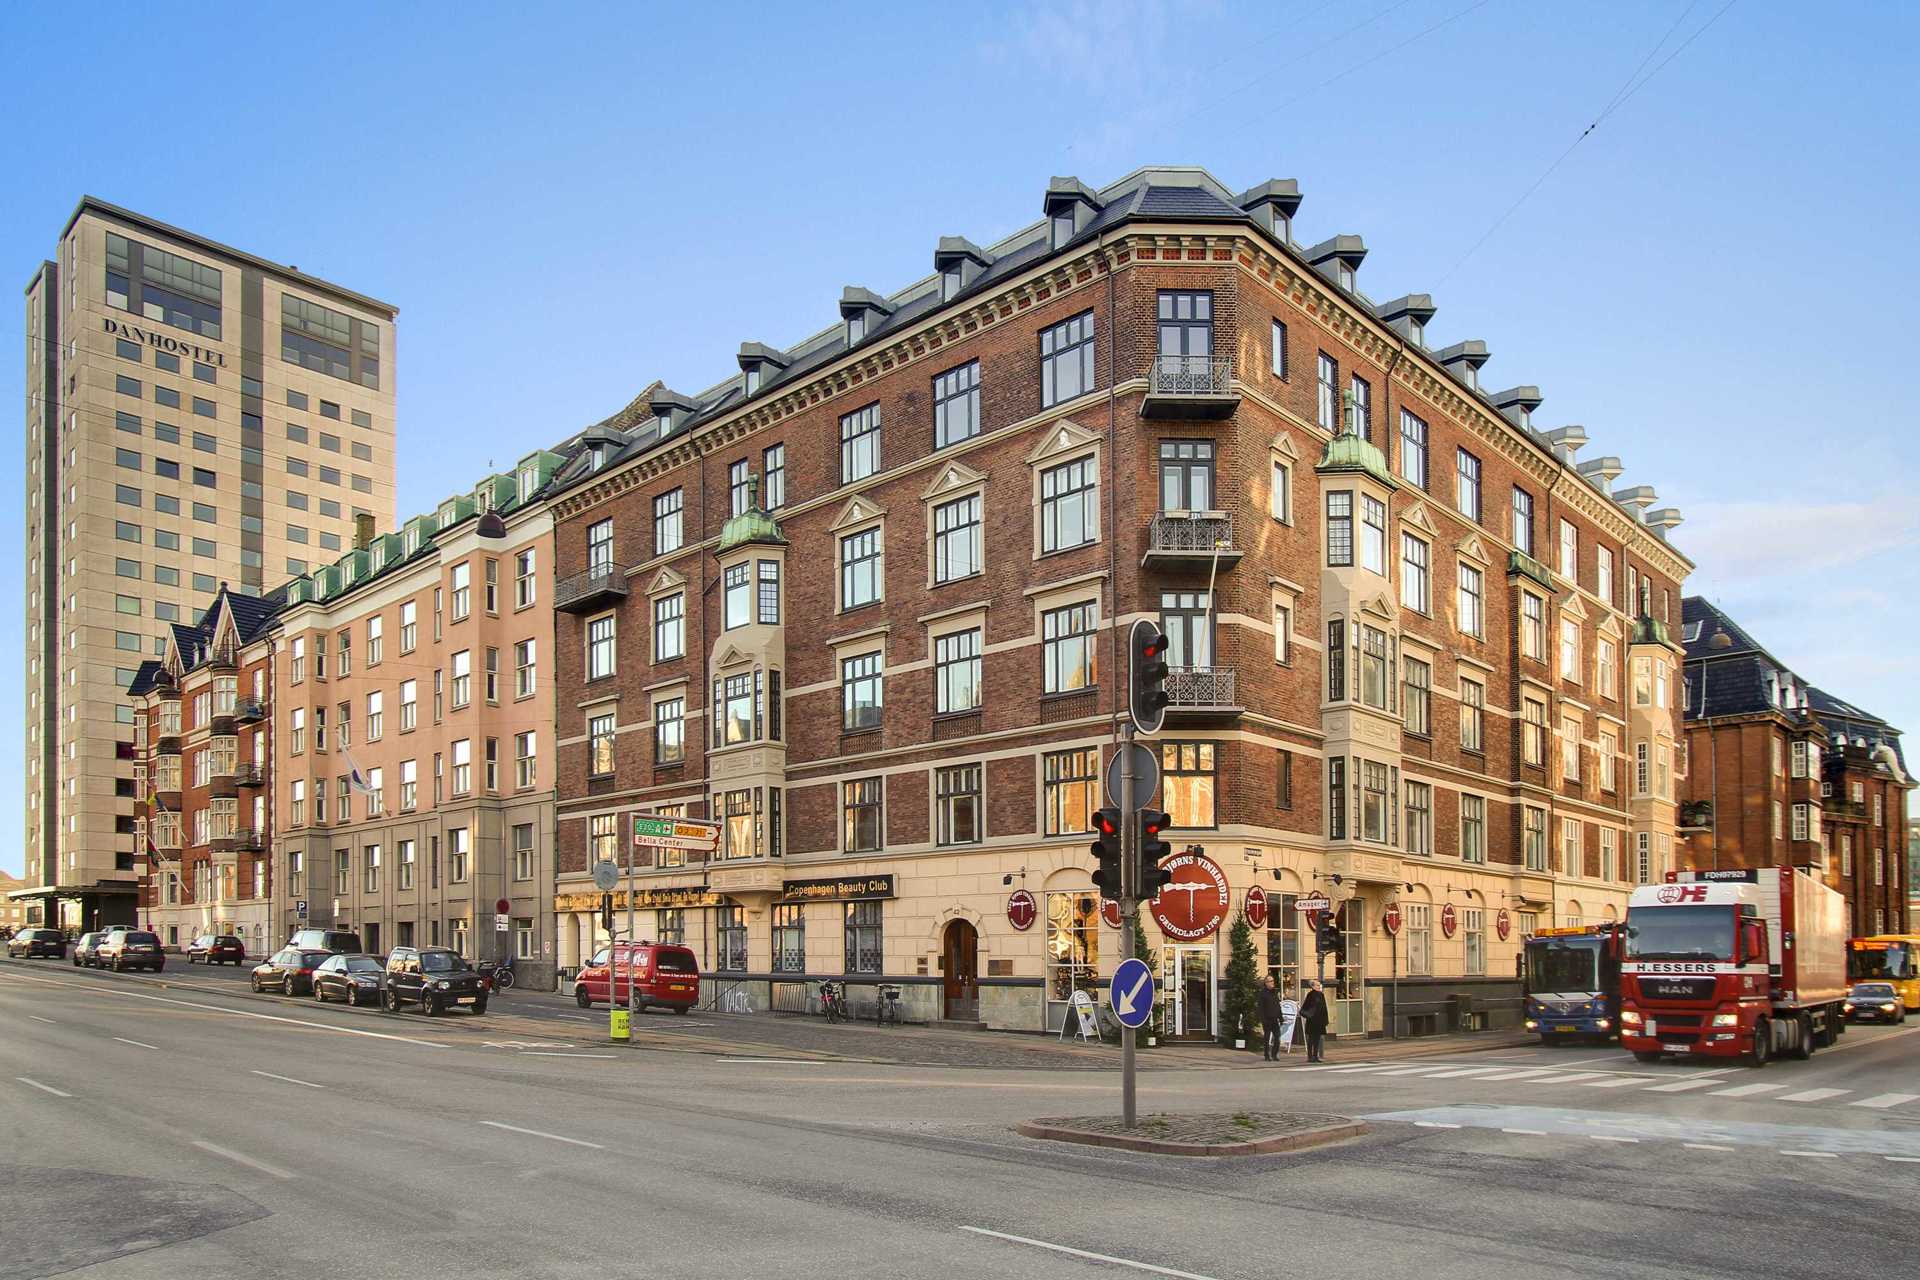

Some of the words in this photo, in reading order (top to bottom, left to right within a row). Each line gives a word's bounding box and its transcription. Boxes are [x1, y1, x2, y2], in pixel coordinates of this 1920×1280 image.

[103, 318, 228, 368] DANHOSTEL
[638, 836, 656, 844] Bella
[659, 838, 683, 846] Center
[789, 884, 836, 897] Copenhagen
[838, 882, 866, 894] Beauty
[869, 880, 888, 891] Club
[1197, 856, 1228, 905] VINHANDEL
[1677, 886, 1709, 902] HE
[1159, 914, 1205, 937] GRUNDLAGT
[1636, 963, 1716, 972] H.ESSERS
